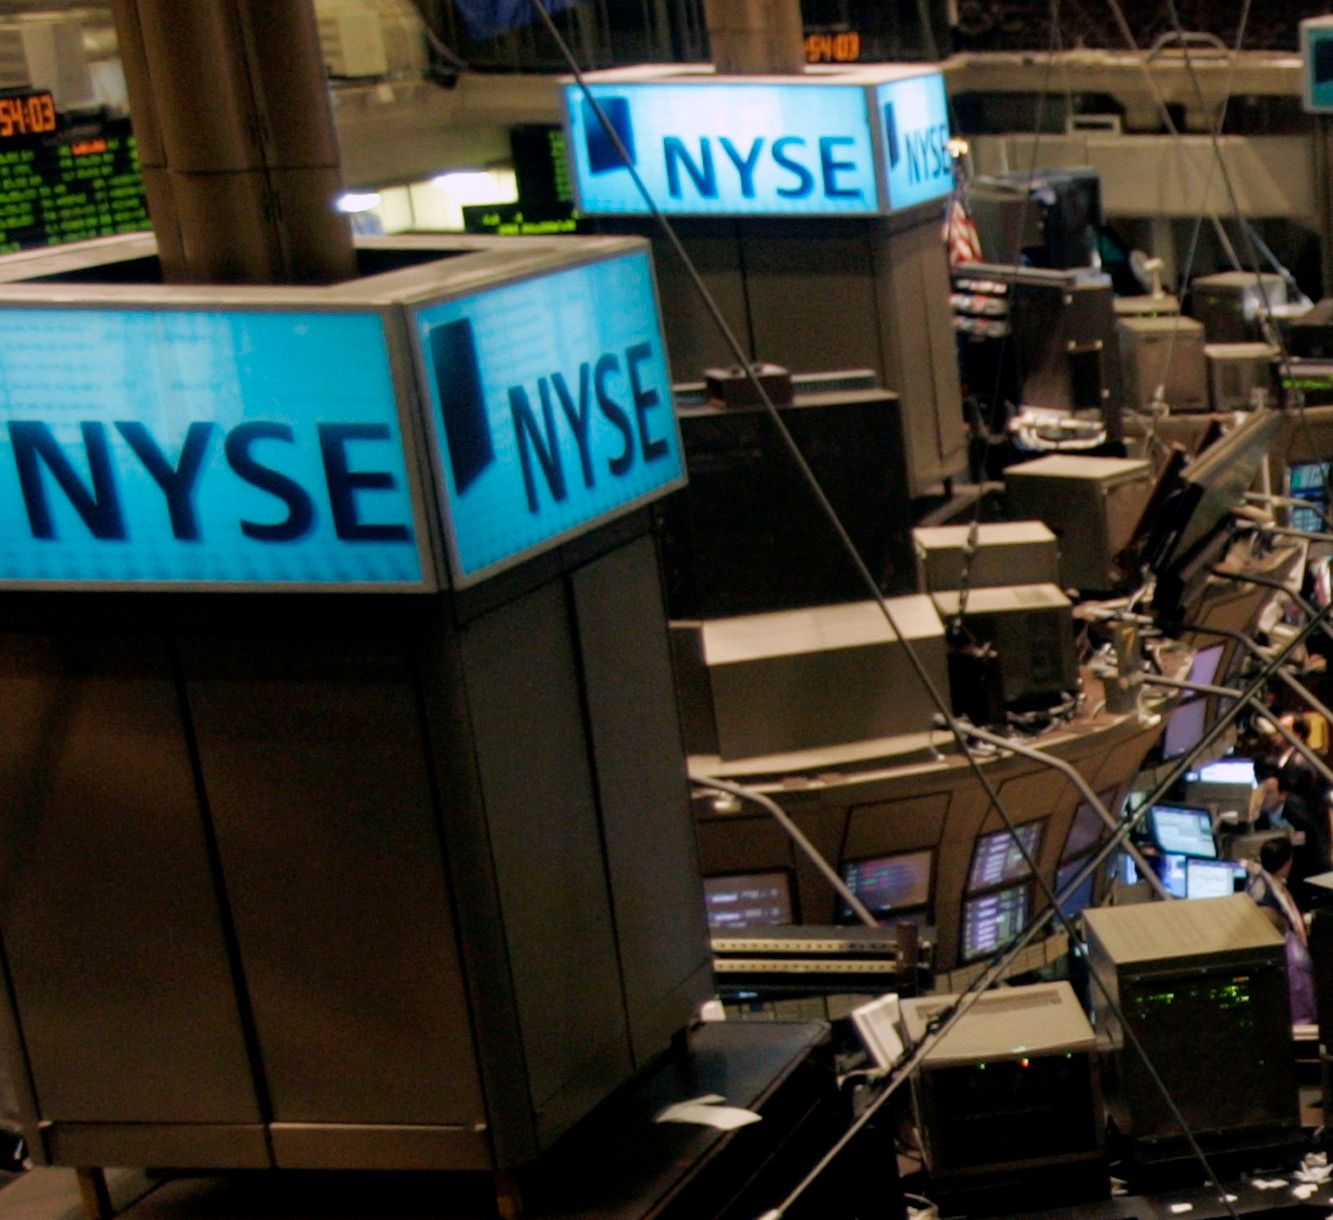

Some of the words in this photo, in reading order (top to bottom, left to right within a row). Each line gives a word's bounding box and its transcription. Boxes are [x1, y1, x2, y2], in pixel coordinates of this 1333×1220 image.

[663, 134, 864, 200] NYSE
[8, 420, 411, 543] NYSE
[508, 342, 668, 514] NYSE
